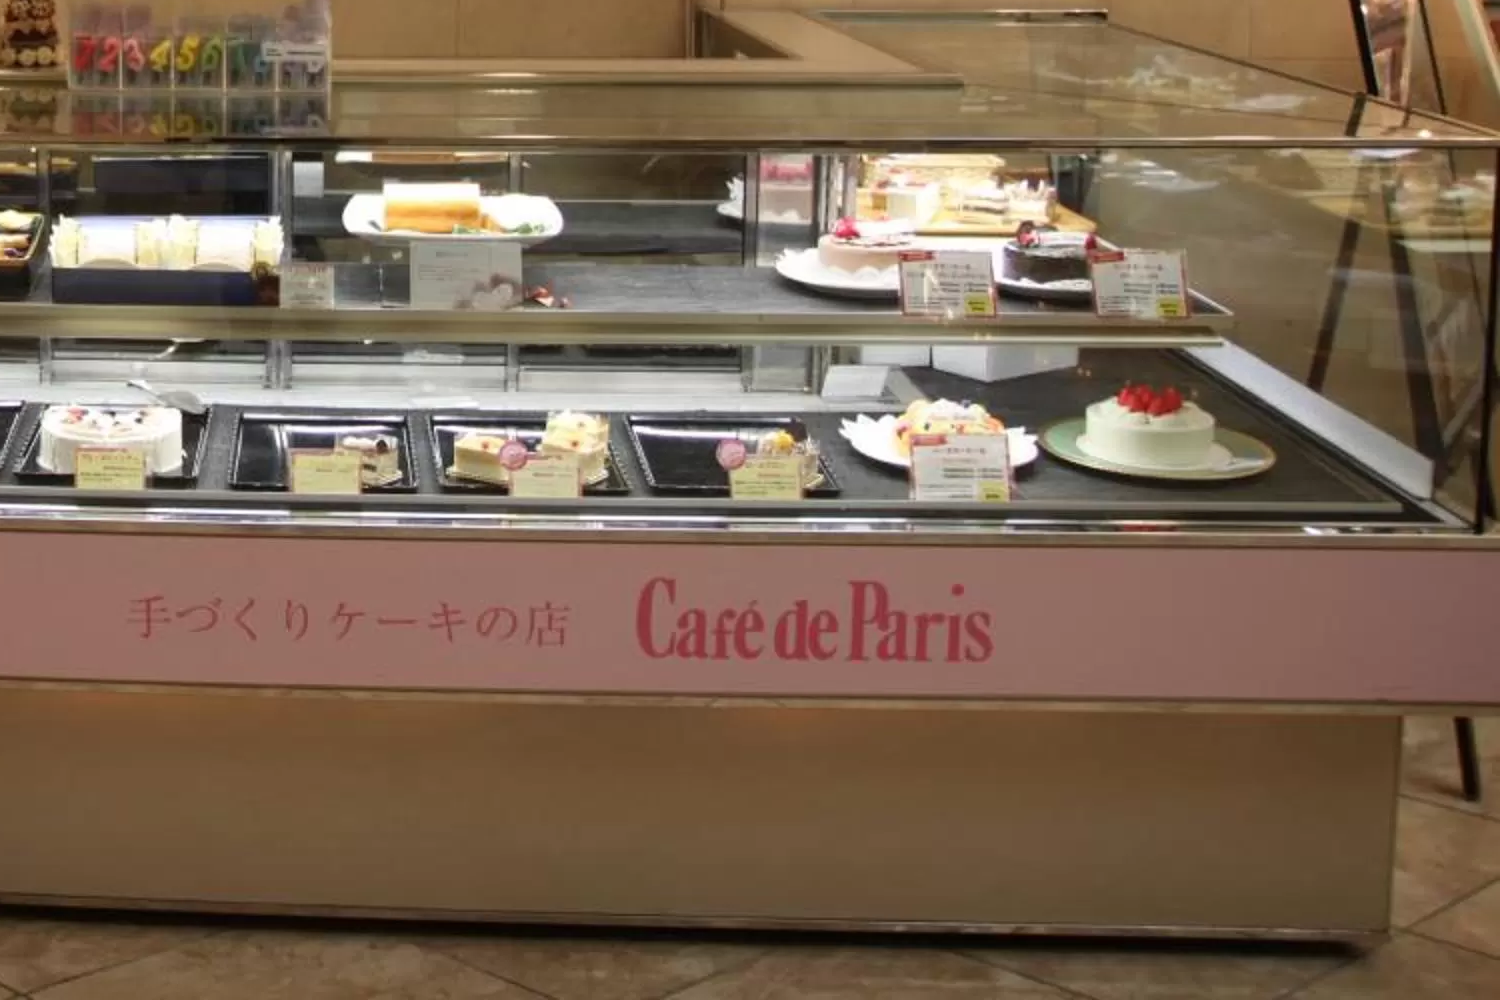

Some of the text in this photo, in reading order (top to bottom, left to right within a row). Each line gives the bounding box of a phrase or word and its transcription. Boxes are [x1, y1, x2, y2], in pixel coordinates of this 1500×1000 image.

[150, 38, 171, 73] 4
[175, 33, 200, 72] 5
[126, 594, 571, 649] 手づくりケーキの店
[635, 576, 996, 663] Café de Paris
